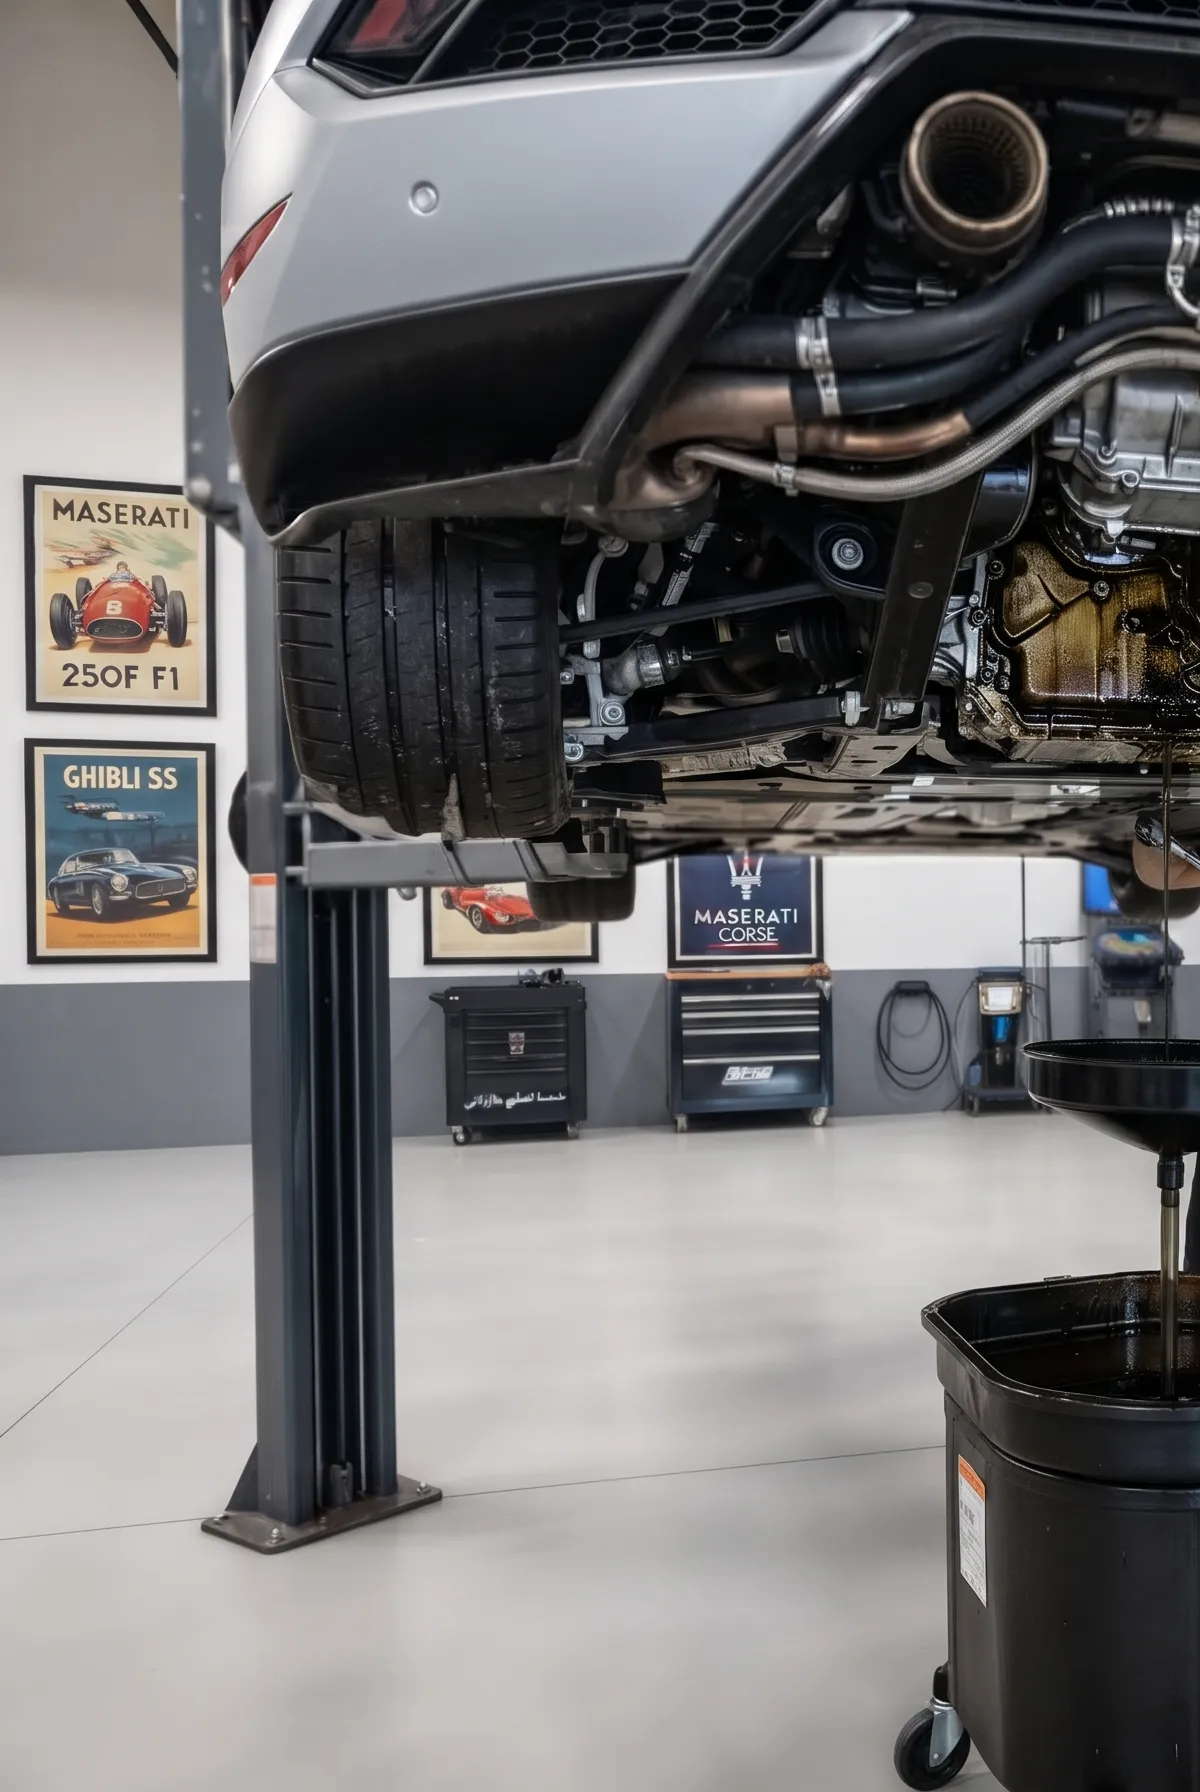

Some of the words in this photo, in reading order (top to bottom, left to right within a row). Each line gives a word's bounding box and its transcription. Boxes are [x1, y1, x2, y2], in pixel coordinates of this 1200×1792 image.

[53, 498, 189, 529] MASERATI
[153, 666, 179, 690] F1
[64, 764, 140, 790] GHIBLI
[148, 766, 178, 789] SS
[694, 909, 798, 924] MASERATI
[719, 927, 778, 942] CORSE
